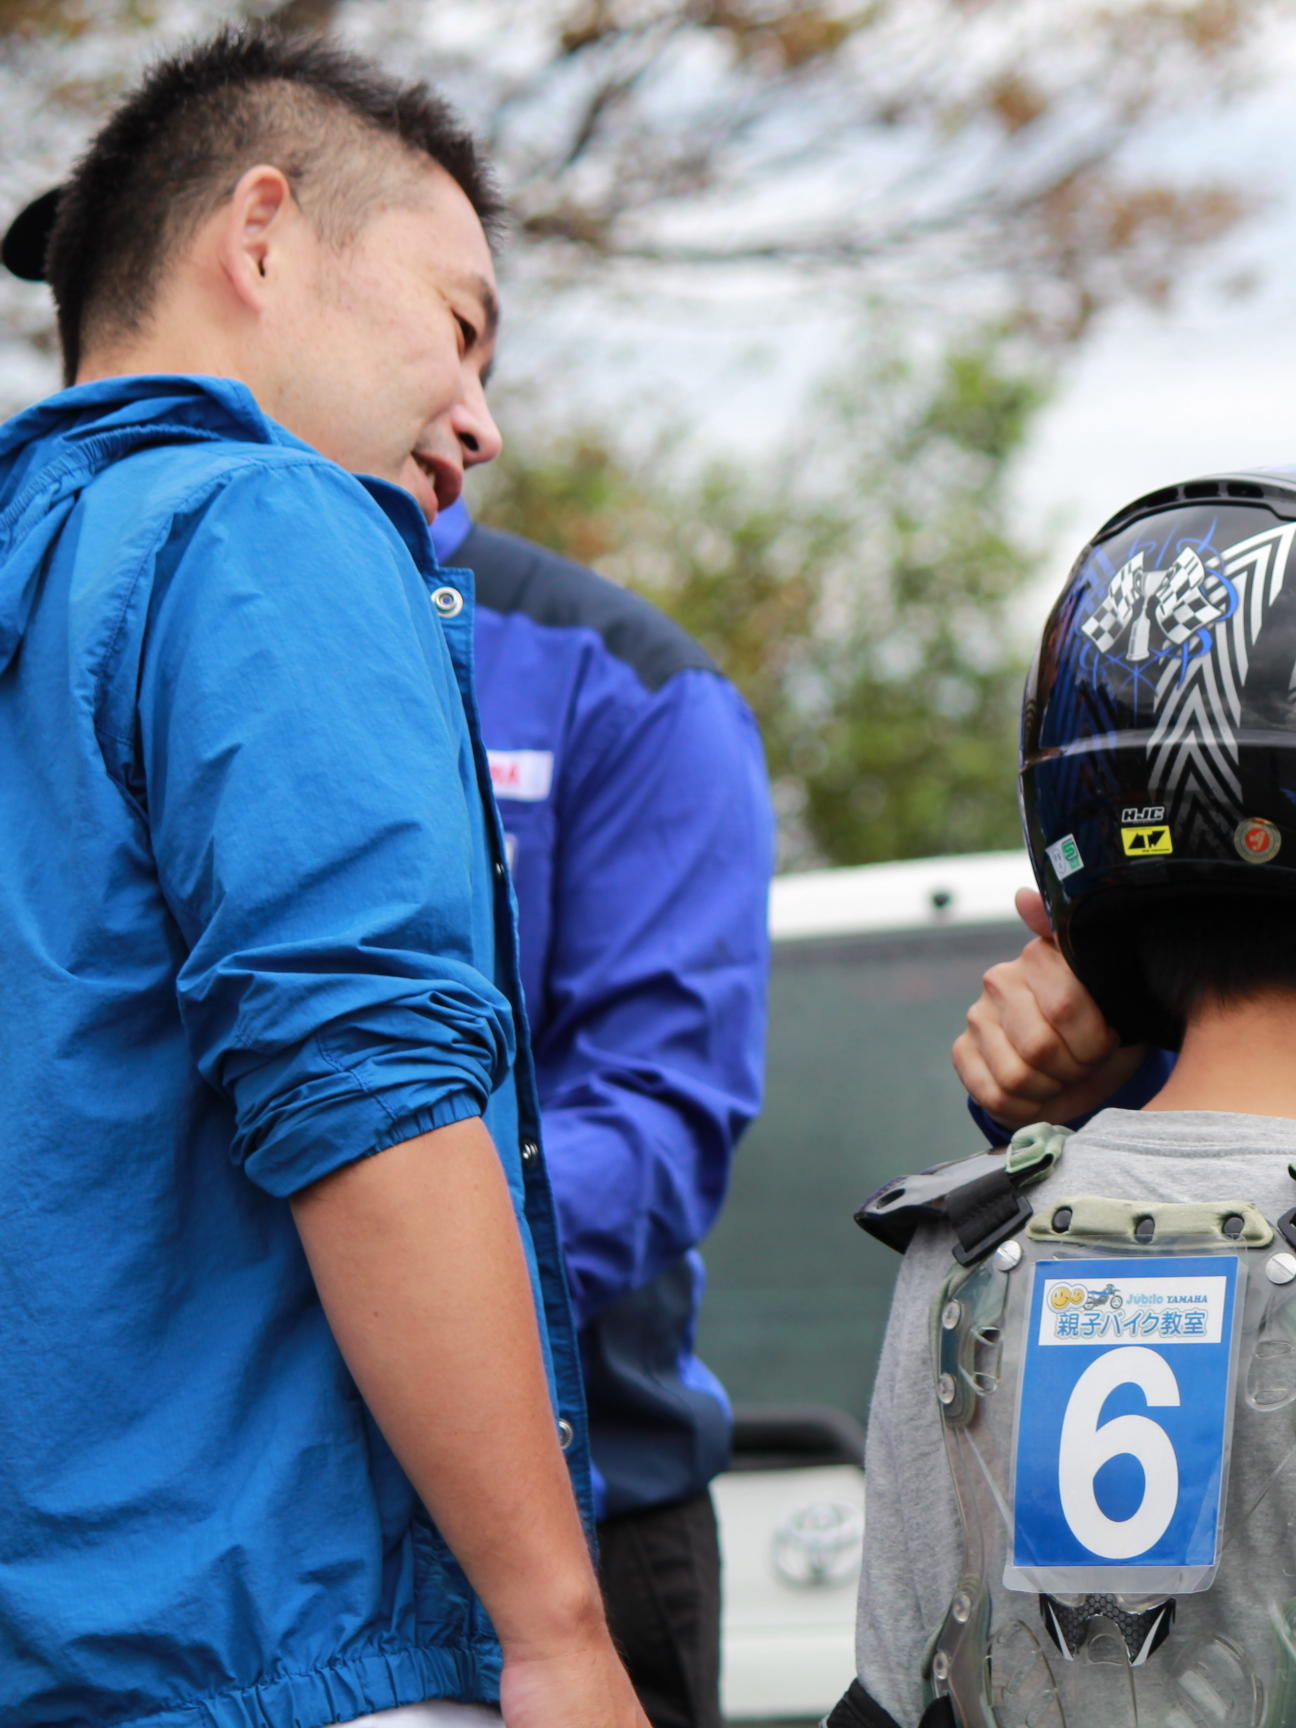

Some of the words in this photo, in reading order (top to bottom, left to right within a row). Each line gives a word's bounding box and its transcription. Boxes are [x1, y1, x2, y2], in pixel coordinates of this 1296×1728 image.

[1121, 806, 1165, 823] HJC
[1166, 1294, 1208, 1304] YAMAHA
[1056, 1312, 1206, 1337] 親子バイク教室
[1058, 1345, 1181, 1560] 6
